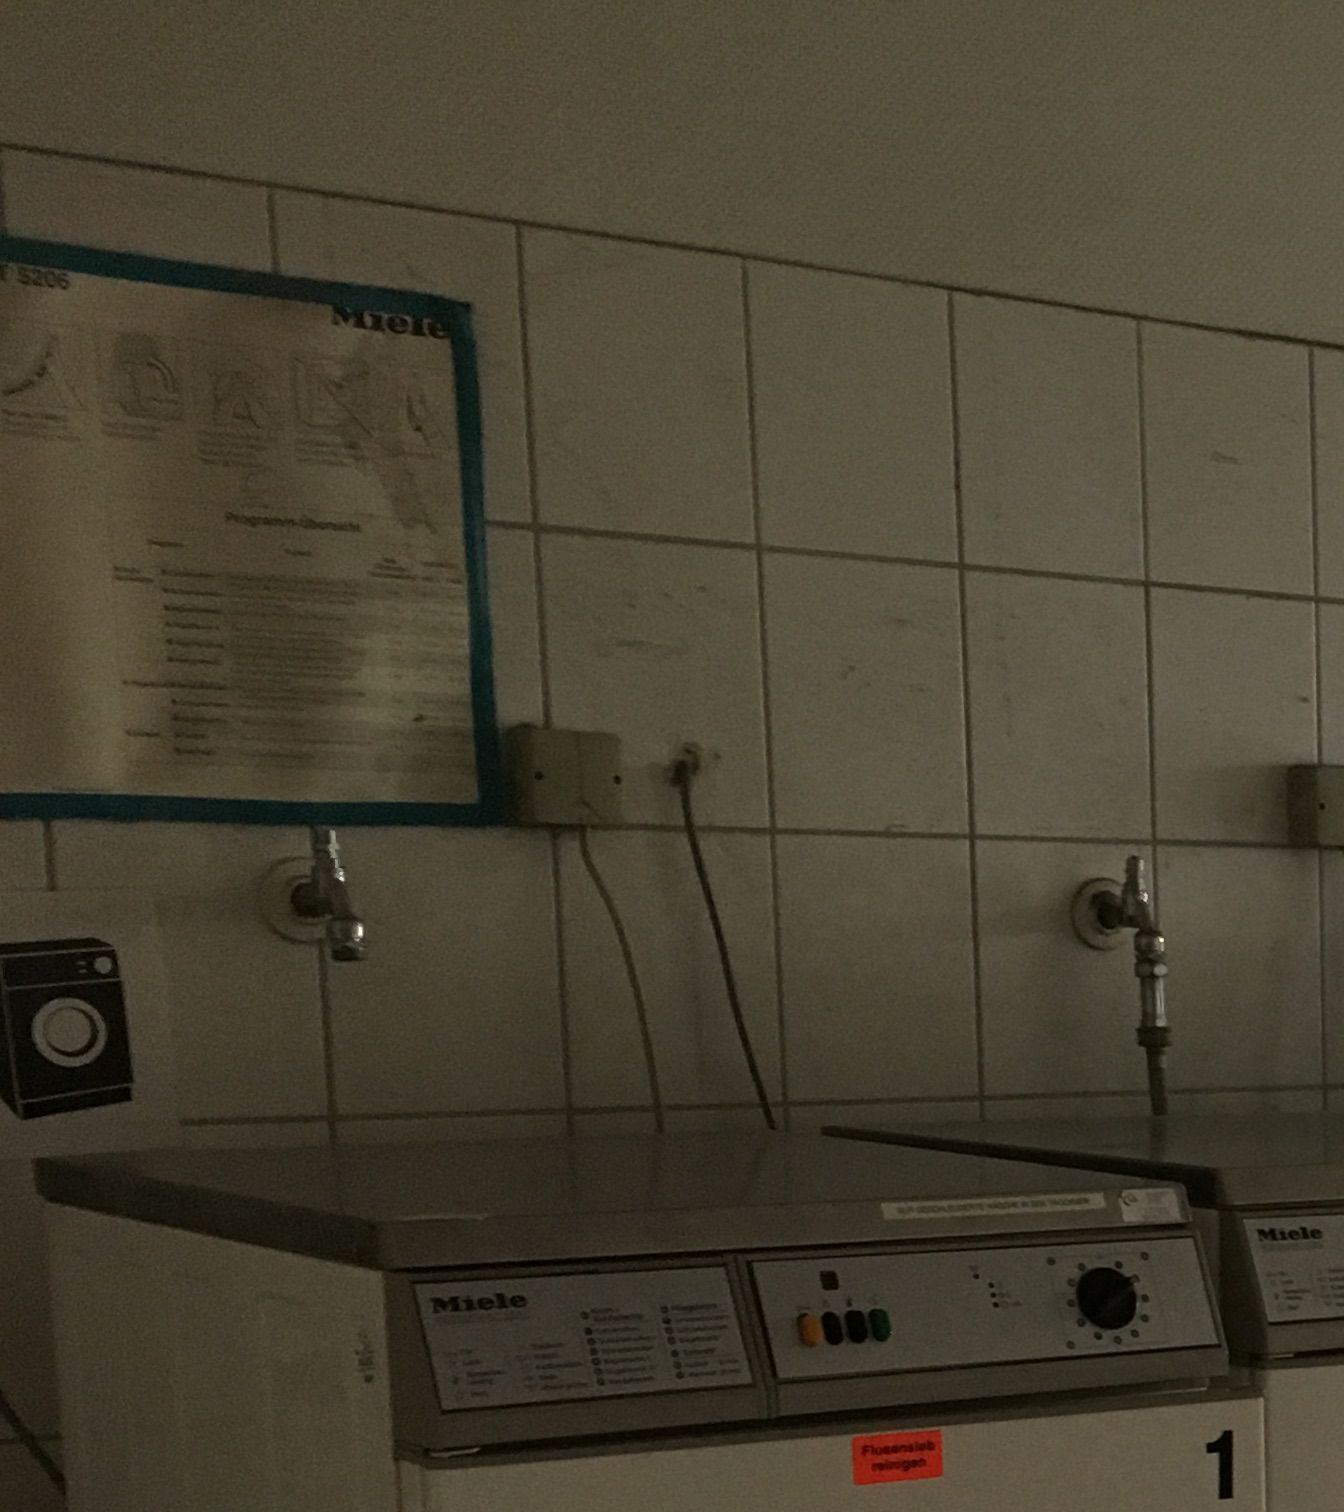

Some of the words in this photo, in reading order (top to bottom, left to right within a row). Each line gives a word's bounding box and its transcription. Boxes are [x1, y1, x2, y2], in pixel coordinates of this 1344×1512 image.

[17, 266, 71, 291] 5206
[331, 305, 451, 340] Miele
[1257, 1226, 1323, 1242] Miele
[430, 1291, 528, 1314] Miele
[1206, 1430, 1234, 1500] 1
